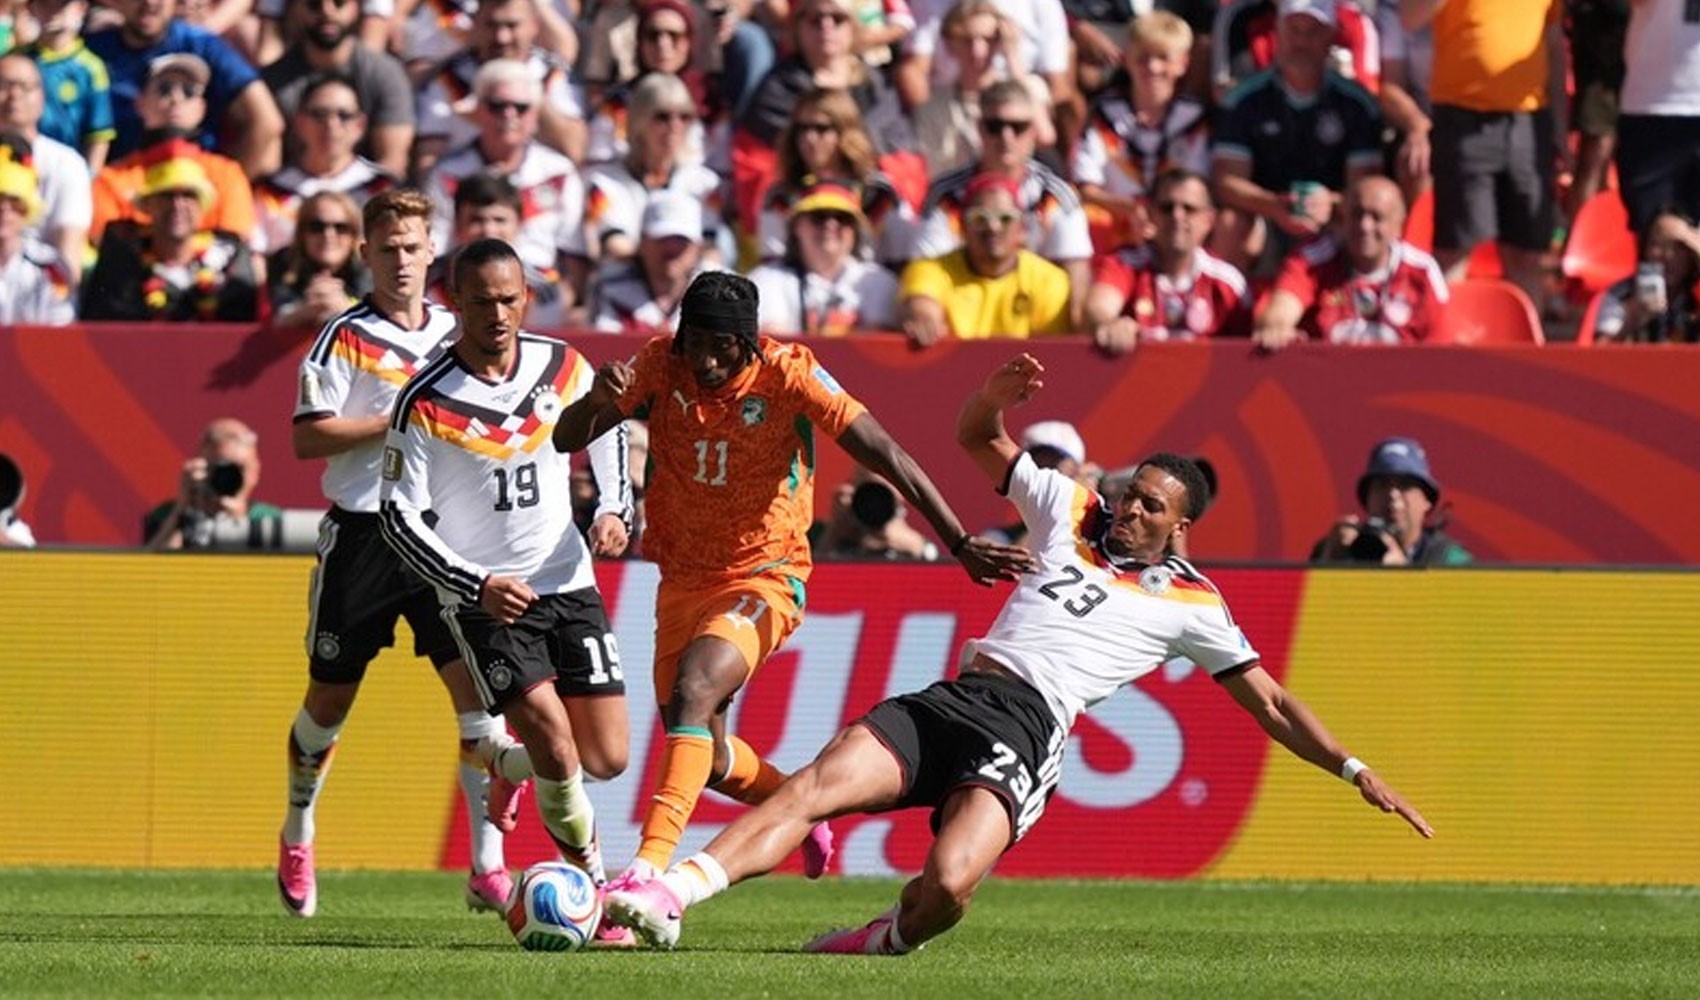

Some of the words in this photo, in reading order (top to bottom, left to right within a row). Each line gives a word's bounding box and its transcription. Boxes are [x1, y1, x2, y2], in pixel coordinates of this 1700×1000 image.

[493, 461, 540, 512] 19
[693, 440, 728, 486] 11
[730, 595, 767, 623] 11
[1038, 564, 1108, 618] 23
[582, 633, 623, 684] 19
[978, 742, 1033, 804] 23
